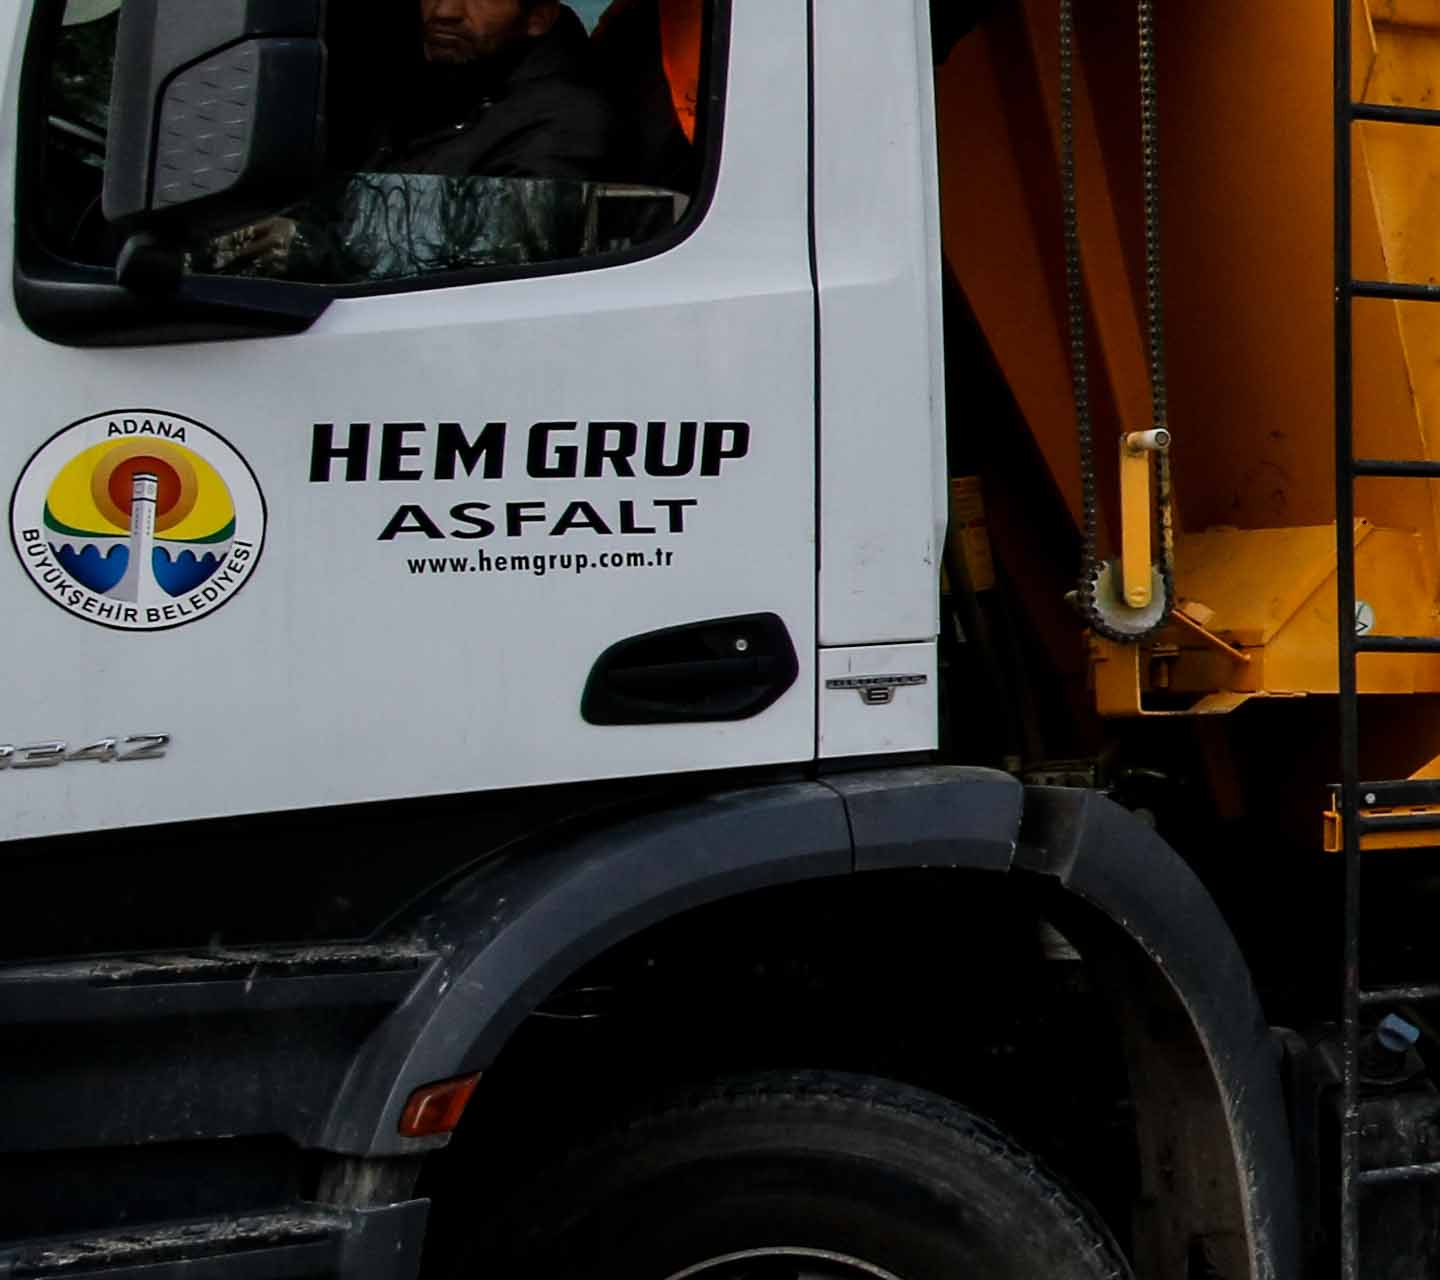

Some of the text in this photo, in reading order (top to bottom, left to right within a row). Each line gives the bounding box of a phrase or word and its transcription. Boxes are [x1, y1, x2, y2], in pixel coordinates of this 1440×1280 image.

[107, 419, 187, 443] ADANA
[308, 421, 751, 483] HEM GRUP
[376, 499, 698, 541] ASFALT
[22, 528, 254, 623] BÜYÜKŞEHİR BELEDİYESİ
[407, 548, 674, 576] www.hemgrup.com.tr
[0, 732, 170, 770] 342
